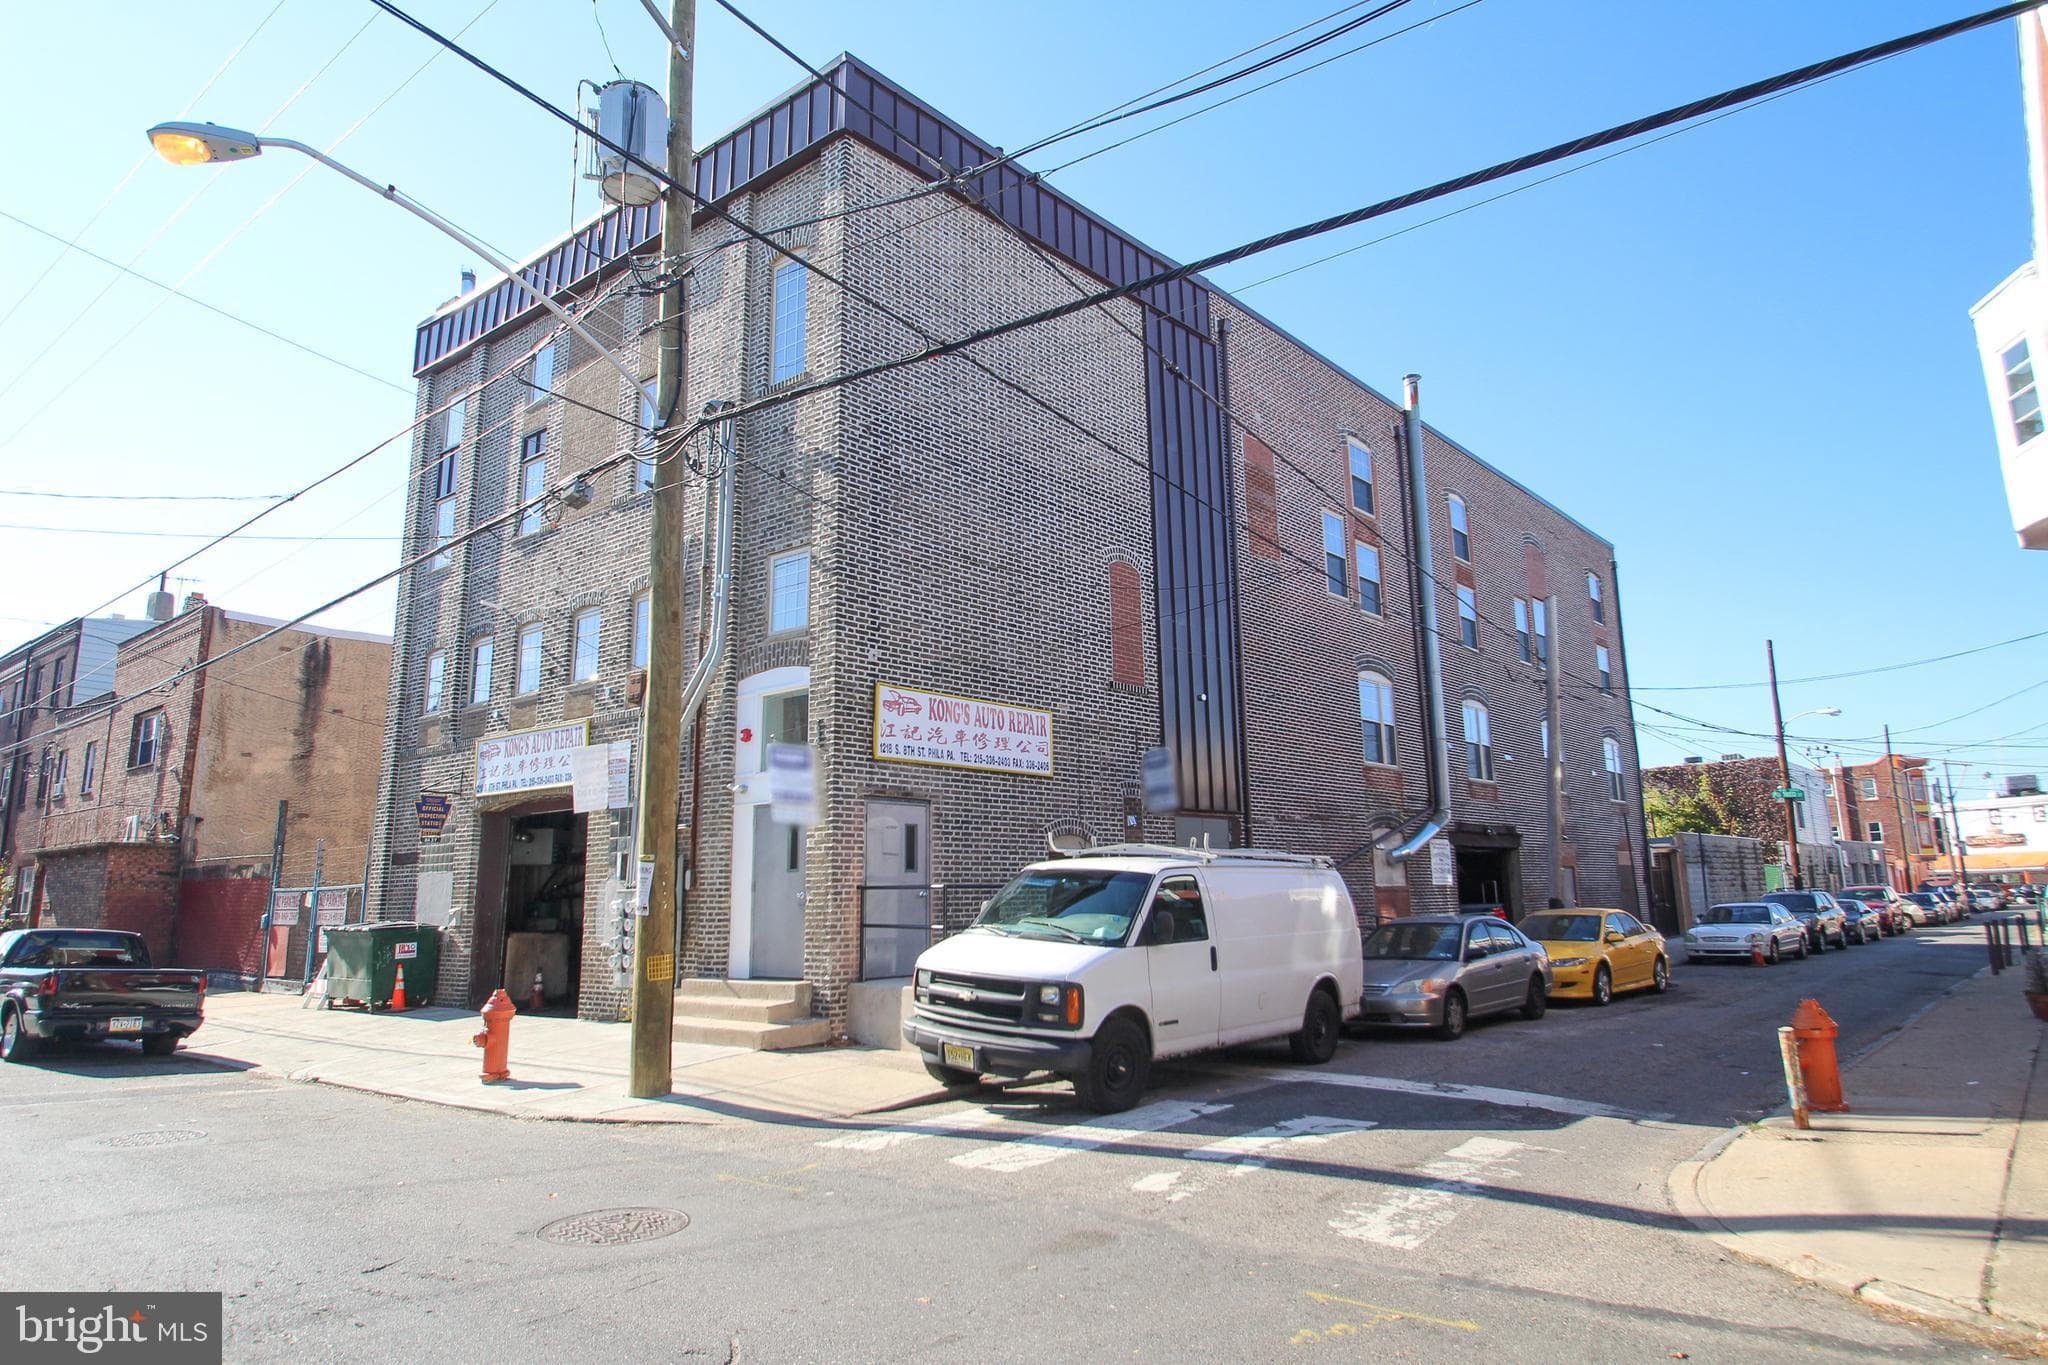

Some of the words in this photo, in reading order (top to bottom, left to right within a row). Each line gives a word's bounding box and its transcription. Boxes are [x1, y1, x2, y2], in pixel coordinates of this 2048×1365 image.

[929, 697, 970, 726] KONG'S
[974, 705, 1005, 731] AUTO
[1008, 711, 1047, 737] REPAIR
[504, 734, 530, 759] KONG'S
[531, 730, 552, 755] AUTO
[554, 726, 584, 750] REPAIR
[880, 719, 1049, 757] 江記汽車修理公司
[479, 754, 571, 780] 江記汽車修理公
[928, 747, 945, 760] PHILA
[960, 751, 973, 763] TEL:
[1012, 757, 1024, 769] FAX:
